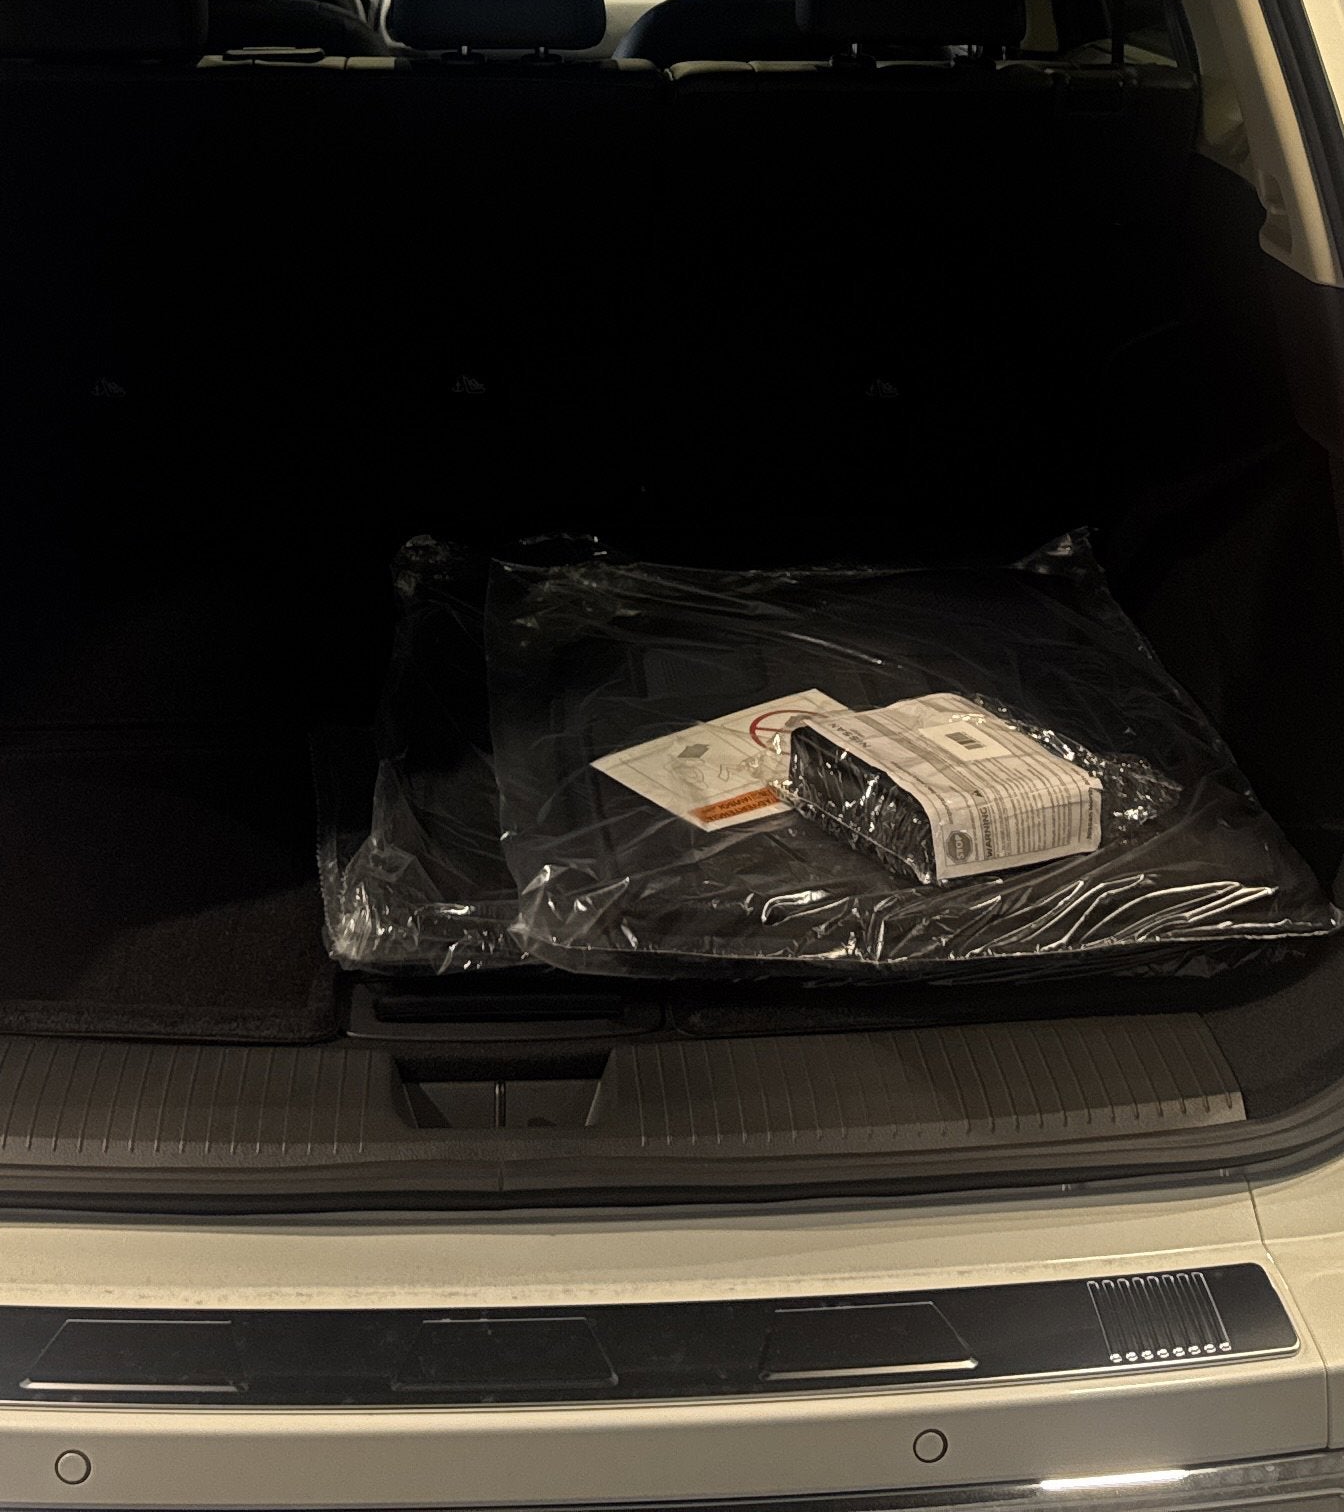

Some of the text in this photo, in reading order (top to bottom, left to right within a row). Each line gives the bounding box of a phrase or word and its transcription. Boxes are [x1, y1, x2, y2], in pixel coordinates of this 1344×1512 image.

[828, 722, 871, 748] NISSAN
[978, 806, 994, 858] WARNING
[954, 833, 966, 860] STOP
